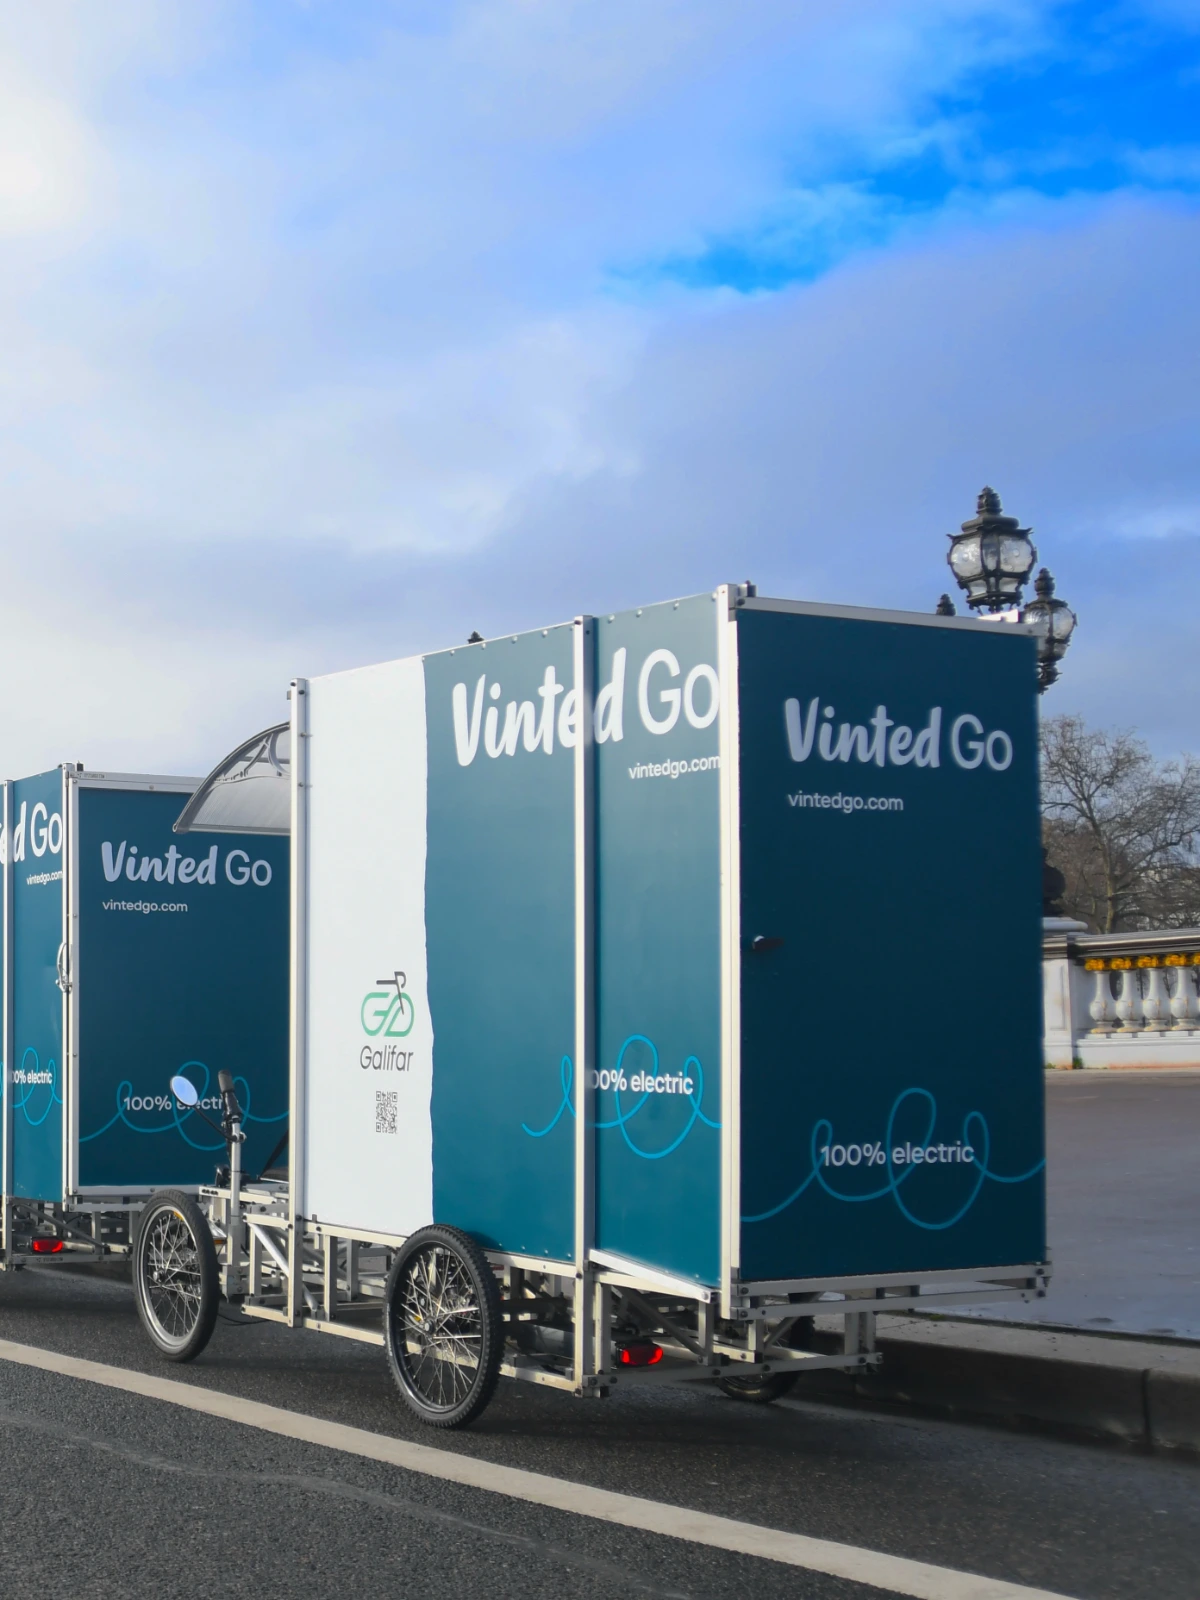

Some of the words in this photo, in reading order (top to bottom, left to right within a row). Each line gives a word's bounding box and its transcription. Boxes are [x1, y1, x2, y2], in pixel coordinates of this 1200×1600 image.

[638, 648, 719, 735] Go
[785, 697, 942, 768] Vinted
[951, 714, 1013, 770] Go
[628, 755, 720, 779] vintedgo.com
[788, 790, 904, 814] vintedgo.com
[31, 802, 62, 857] Go
[101, 840, 218, 885] Vinted
[225, 850, 272, 886] Go
[102, 899, 188, 914] vintedgo.com
[360, 1045, 414, 1072] Galifar
[27, 1069, 52, 1084] electric
[593, 1068, 627, 1092] 00%
[631, 1070, 694, 1094] electric
[123, 1095, 172, 1111] 100%
[820, 1141, 886, 1167] 100%
[892, 1140, 975, 1165] electric
